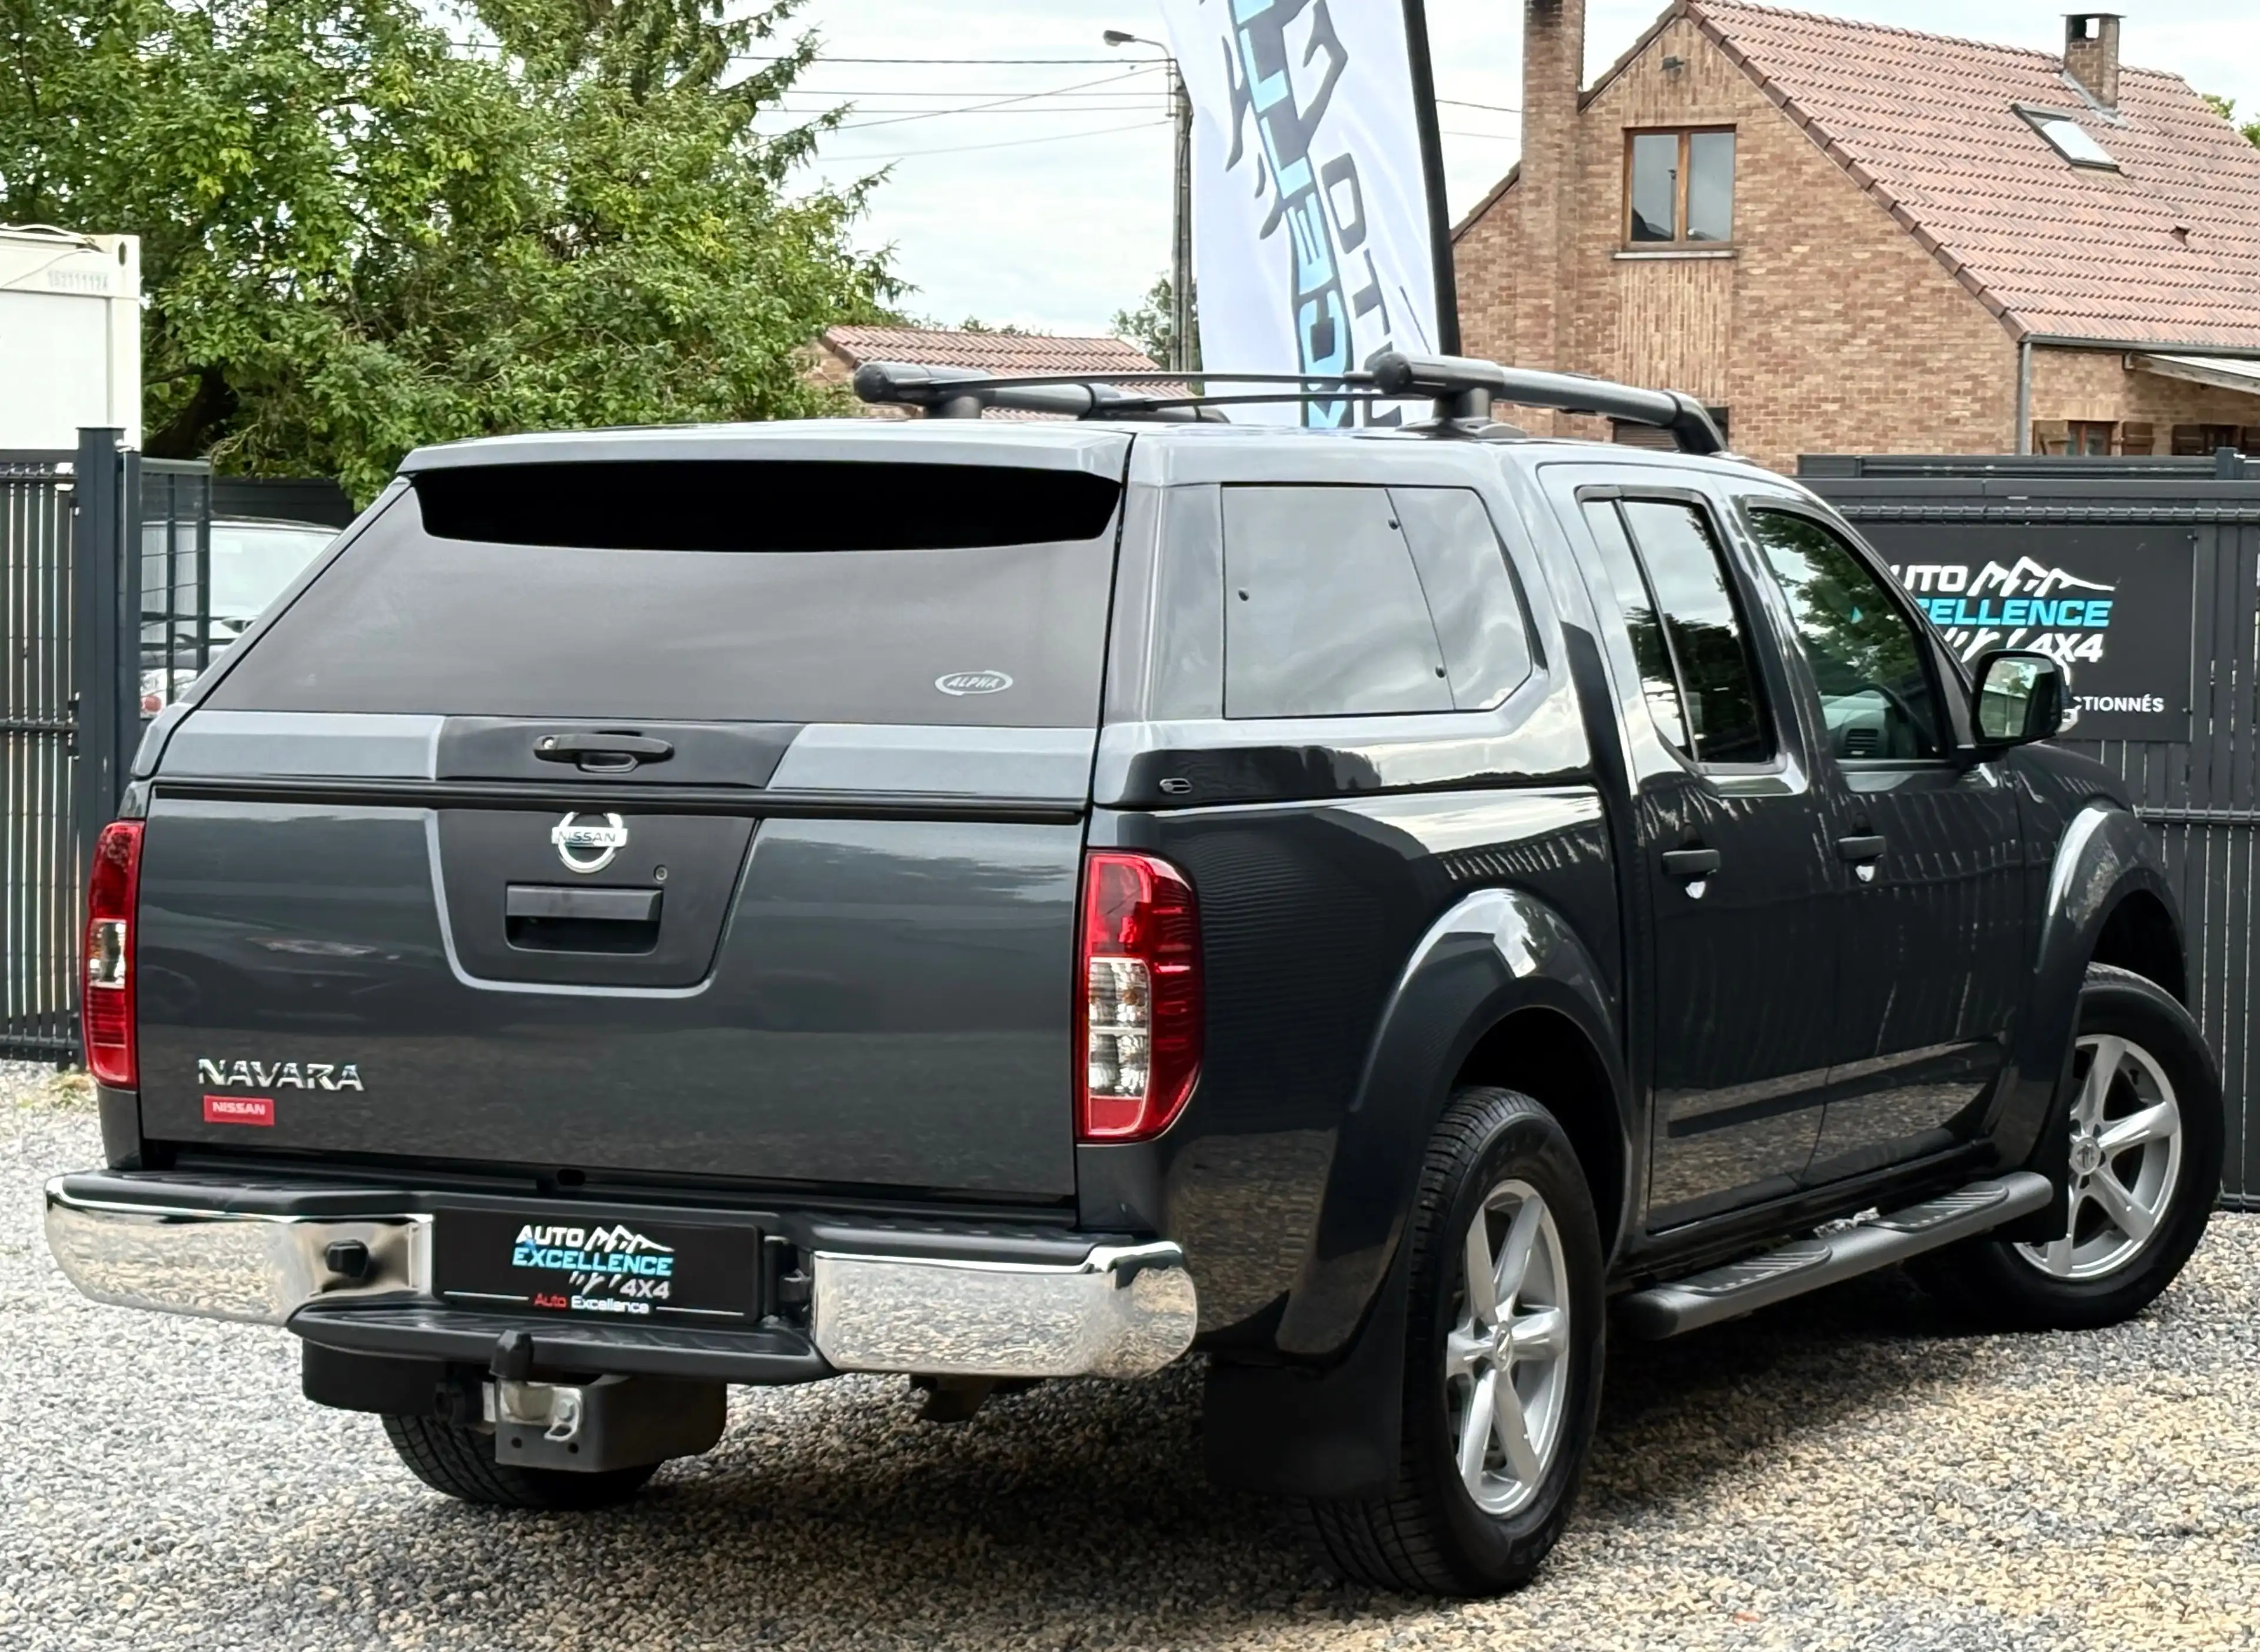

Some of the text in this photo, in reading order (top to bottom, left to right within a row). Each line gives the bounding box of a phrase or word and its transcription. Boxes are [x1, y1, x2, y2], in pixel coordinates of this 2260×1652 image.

[1890, 565, 1969, 592] UTO
[2025, 633, 2104, 663] 4X4
[946, 676, 1000, 688] ALPHA
[558, 830, 616, 843] NISSAN
[198, 1058, 365, 1091] NAVARA
[212, 1102, 266, 1115] NISSAN
[515, 1224, 585, 1248] AUTO
[512, 1247, 674, 1277] EXCELLENCE
[620, 1278, 670, 1299] 4X4
[533, 1293, 650, 1314] Auto Excellence
